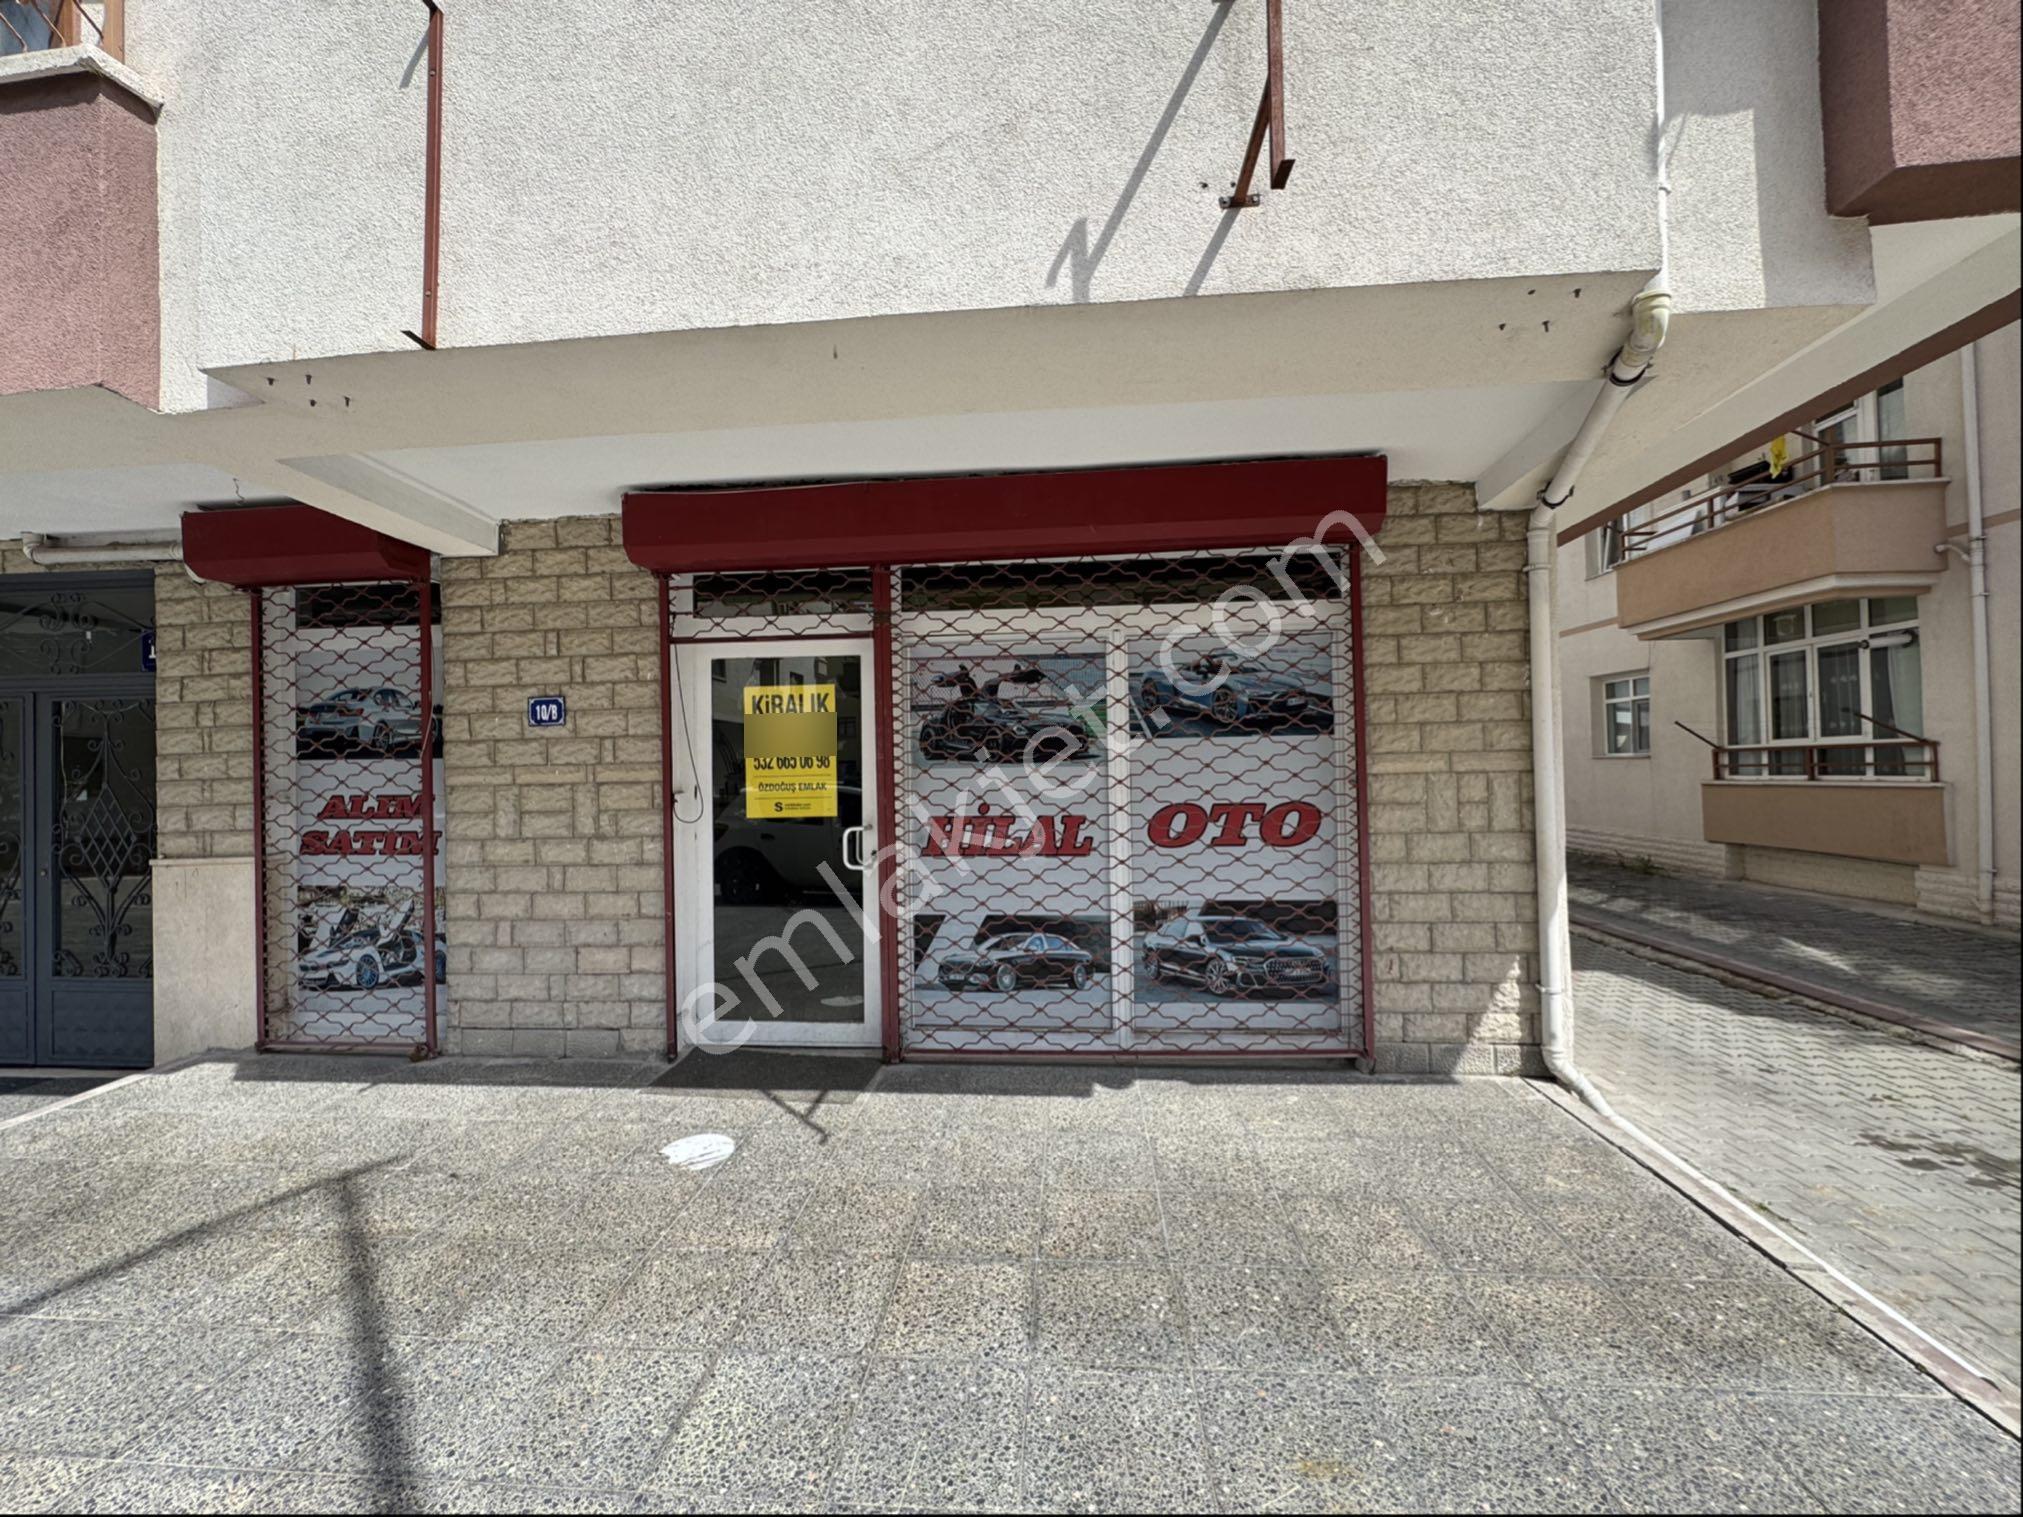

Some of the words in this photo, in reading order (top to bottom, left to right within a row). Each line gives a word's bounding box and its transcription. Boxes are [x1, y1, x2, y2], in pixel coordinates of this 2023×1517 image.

[536, 704, 558, 721] 10/B
[798, 782, 828, 792] EMLAK
[316, 794, 436, 820] ALIM
[920, 802, 1093, 857] HİLAL
[1147, 800, 1323, 849] OTO
[299, 830, 443, 856] SATIM
